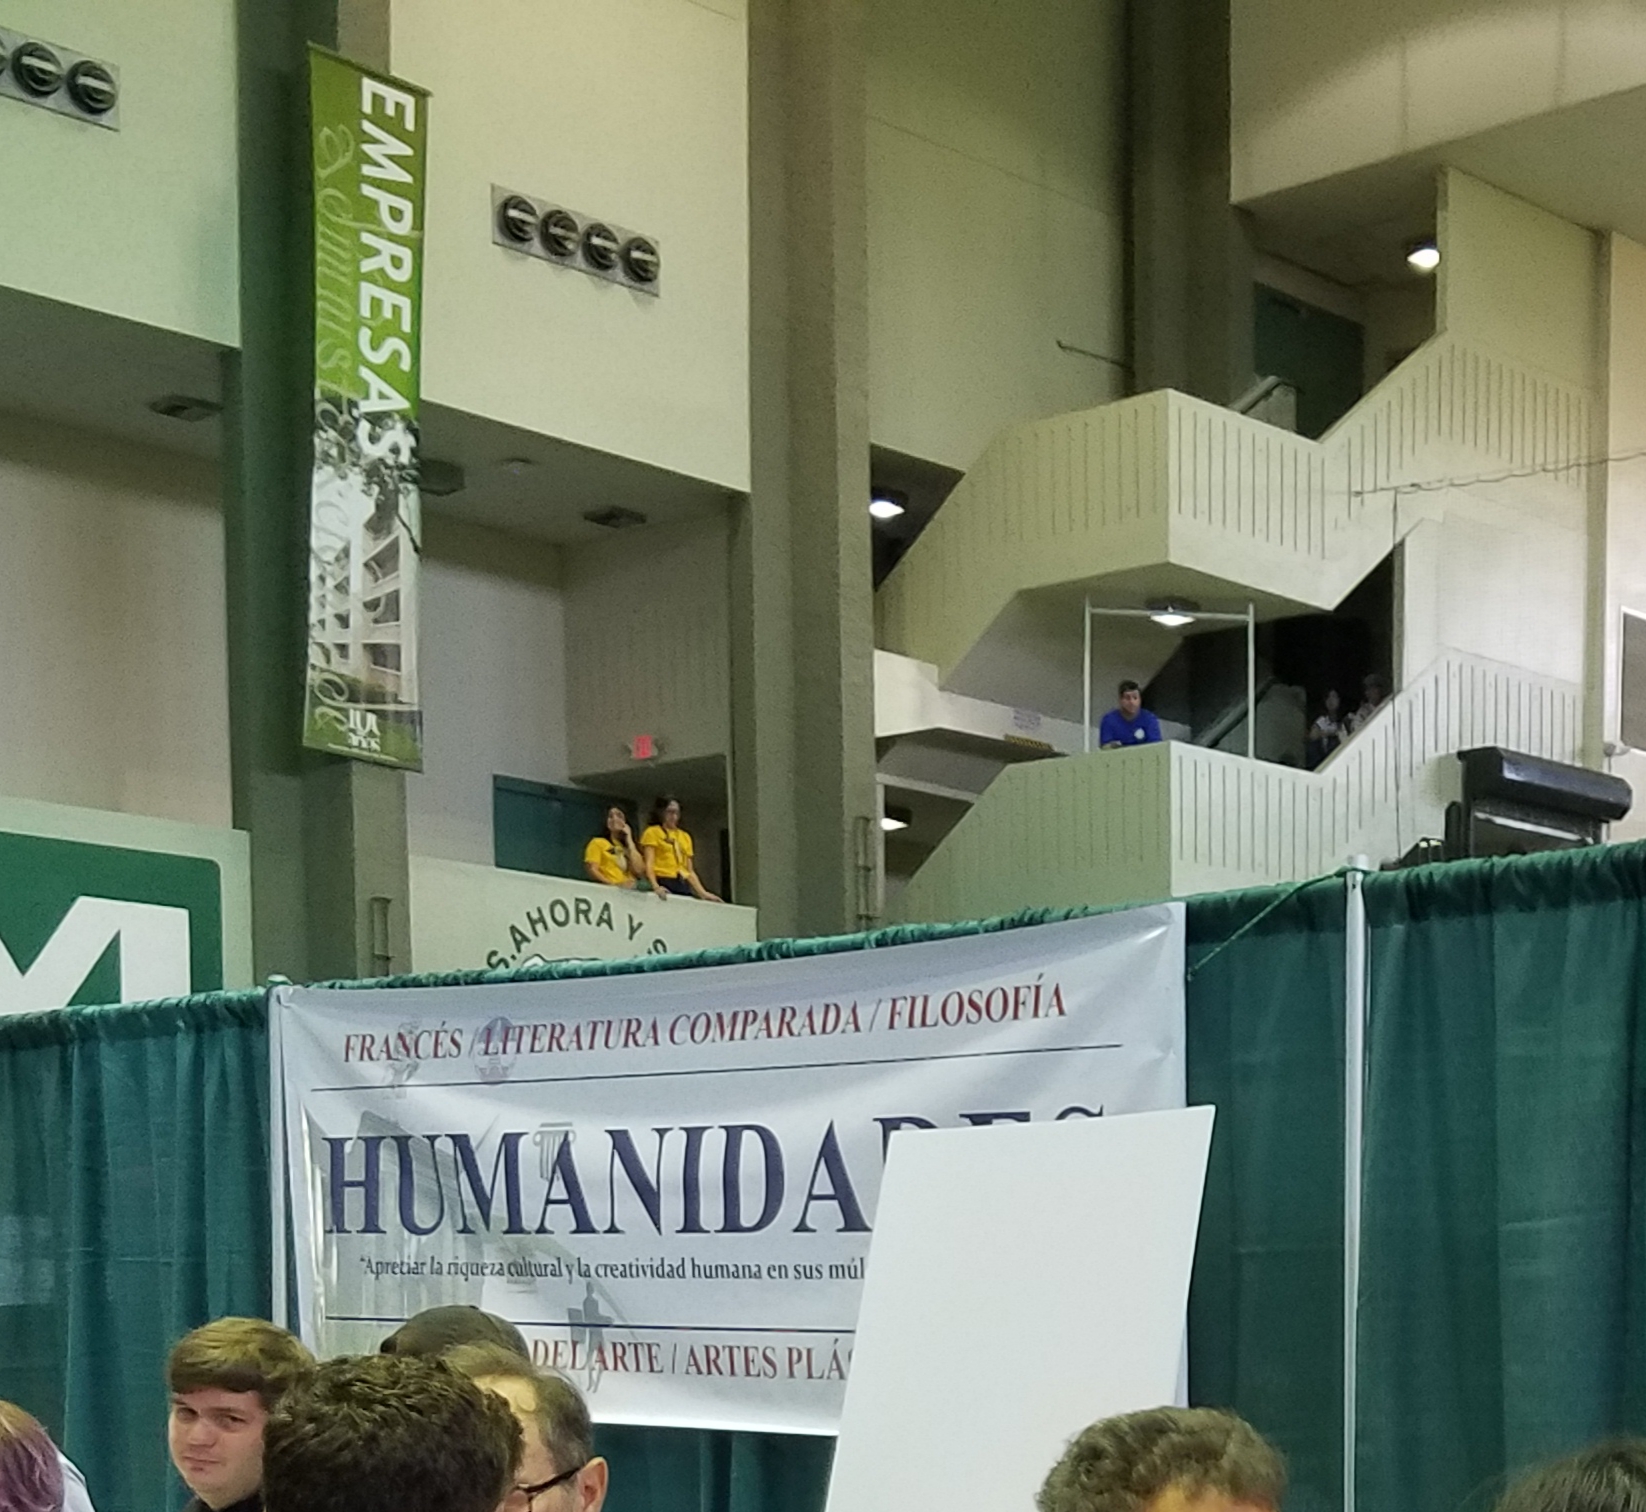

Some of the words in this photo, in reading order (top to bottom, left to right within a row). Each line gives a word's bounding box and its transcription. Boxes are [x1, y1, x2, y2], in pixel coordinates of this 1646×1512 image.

[358, 77, 416, 464] EMPRESAS
[344, 1020, 464, 1063] FRANCÉS
[482, 1016, 661, 1058] LITERATURA
[669, 1000, 862, 1047] COMPARADA
[887, 973, 1066, 1031] FILOSOFÍA
[322, 1105, 1104, 1236] HUMANIDA
[430, 1255, 443, 1276] la
[446, 1256, 504, 1282] riqueza
[507, 1256, 563, 1278] cultural
[565, 1262, 576, 1284] y
[577, 1257, 591, 1278] la
[595, 1257, 687, 1280] creatividad
[691, 1256, 762, 1280] humana
[766, 1263, 789, 1280] en
[793, 1262, 823, 1280] sus
[532, 1338, 587, 1371] DEL
[592, 1339, 664, 1374] ARTE
[684, 1344, 777, 1380] ARTES
[786, 1337, 853, 1381] PLÁ
